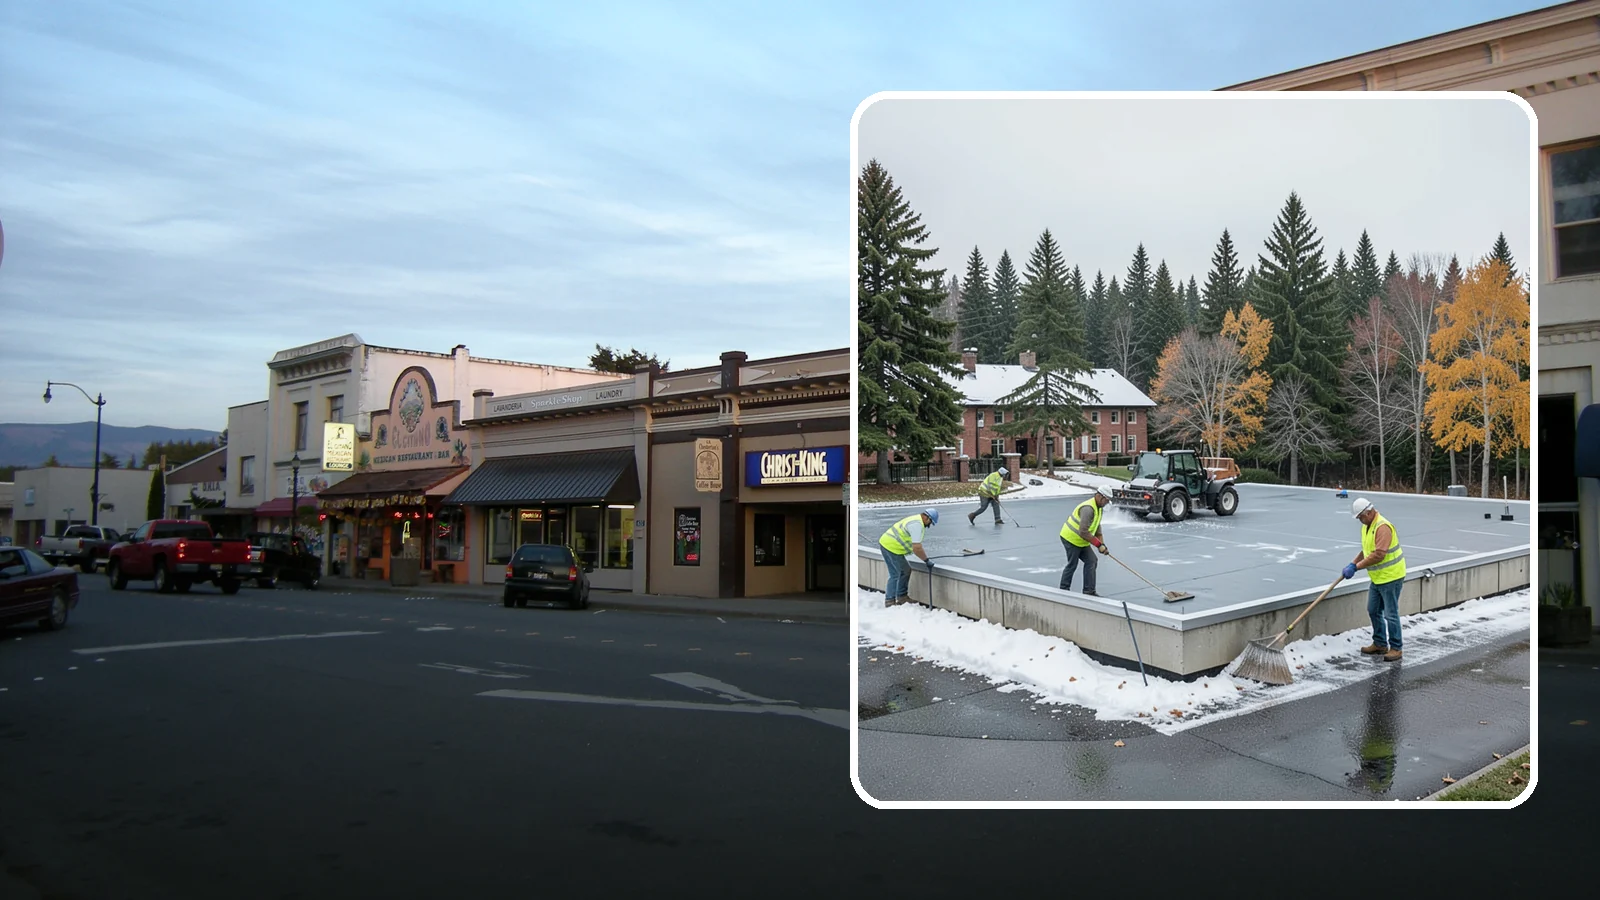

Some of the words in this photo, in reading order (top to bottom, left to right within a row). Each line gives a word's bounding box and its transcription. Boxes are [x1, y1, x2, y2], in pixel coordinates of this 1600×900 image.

[562, 394, 583, 406] Shop
[595, 388, 624, 400] LAUNDRY
[493, 402, 523, 413] LAVANDERIA
[374, 455, 396, 464] MEXICAN
[397, 451, 433, 462] RESTAURANT
[437, 450, 450, 459] BAR
[761, 452, 797, 478] CHRIST
[799, 450, 827, 476] KING
[696, 481, 709, 489] Coffee
